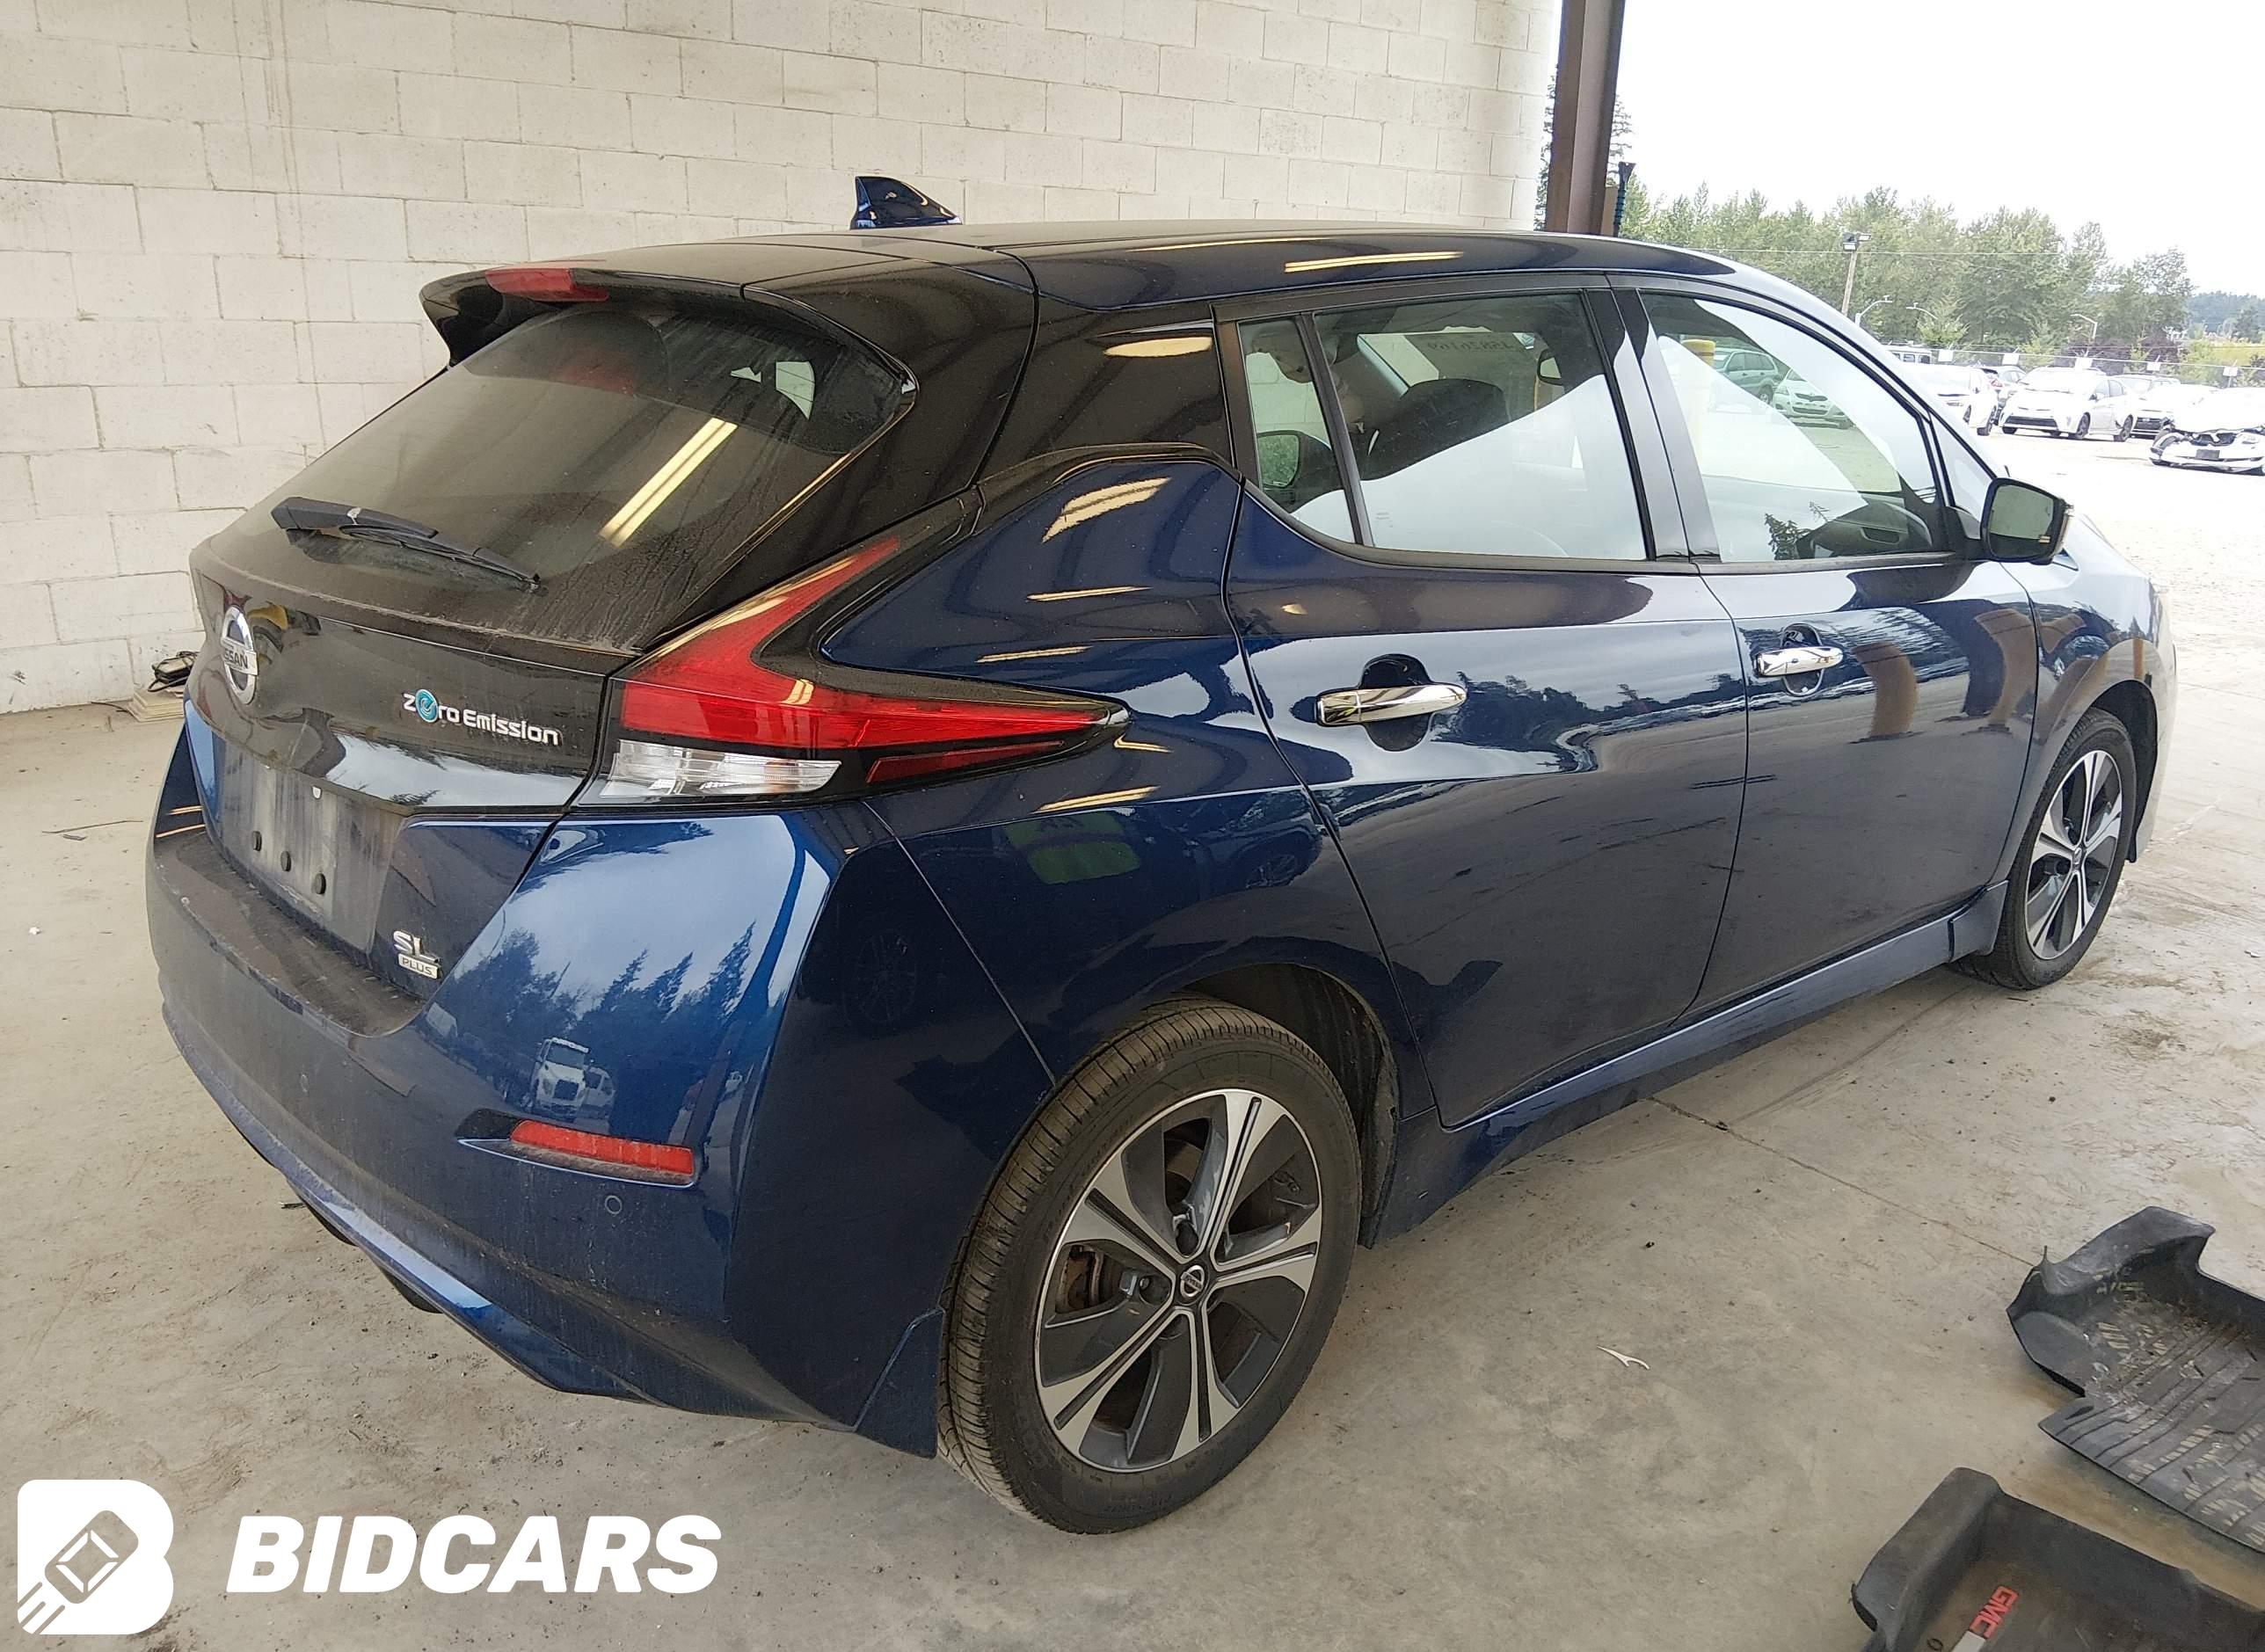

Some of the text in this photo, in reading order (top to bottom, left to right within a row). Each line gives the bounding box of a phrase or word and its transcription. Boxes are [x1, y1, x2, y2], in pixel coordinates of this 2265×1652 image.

[462, 709, 561, 746] Emission
[393, 930, 439, 964] SL
[401, 957, 433, 976] PLUS
[1970, 1585, 2020, 1640] GMC
